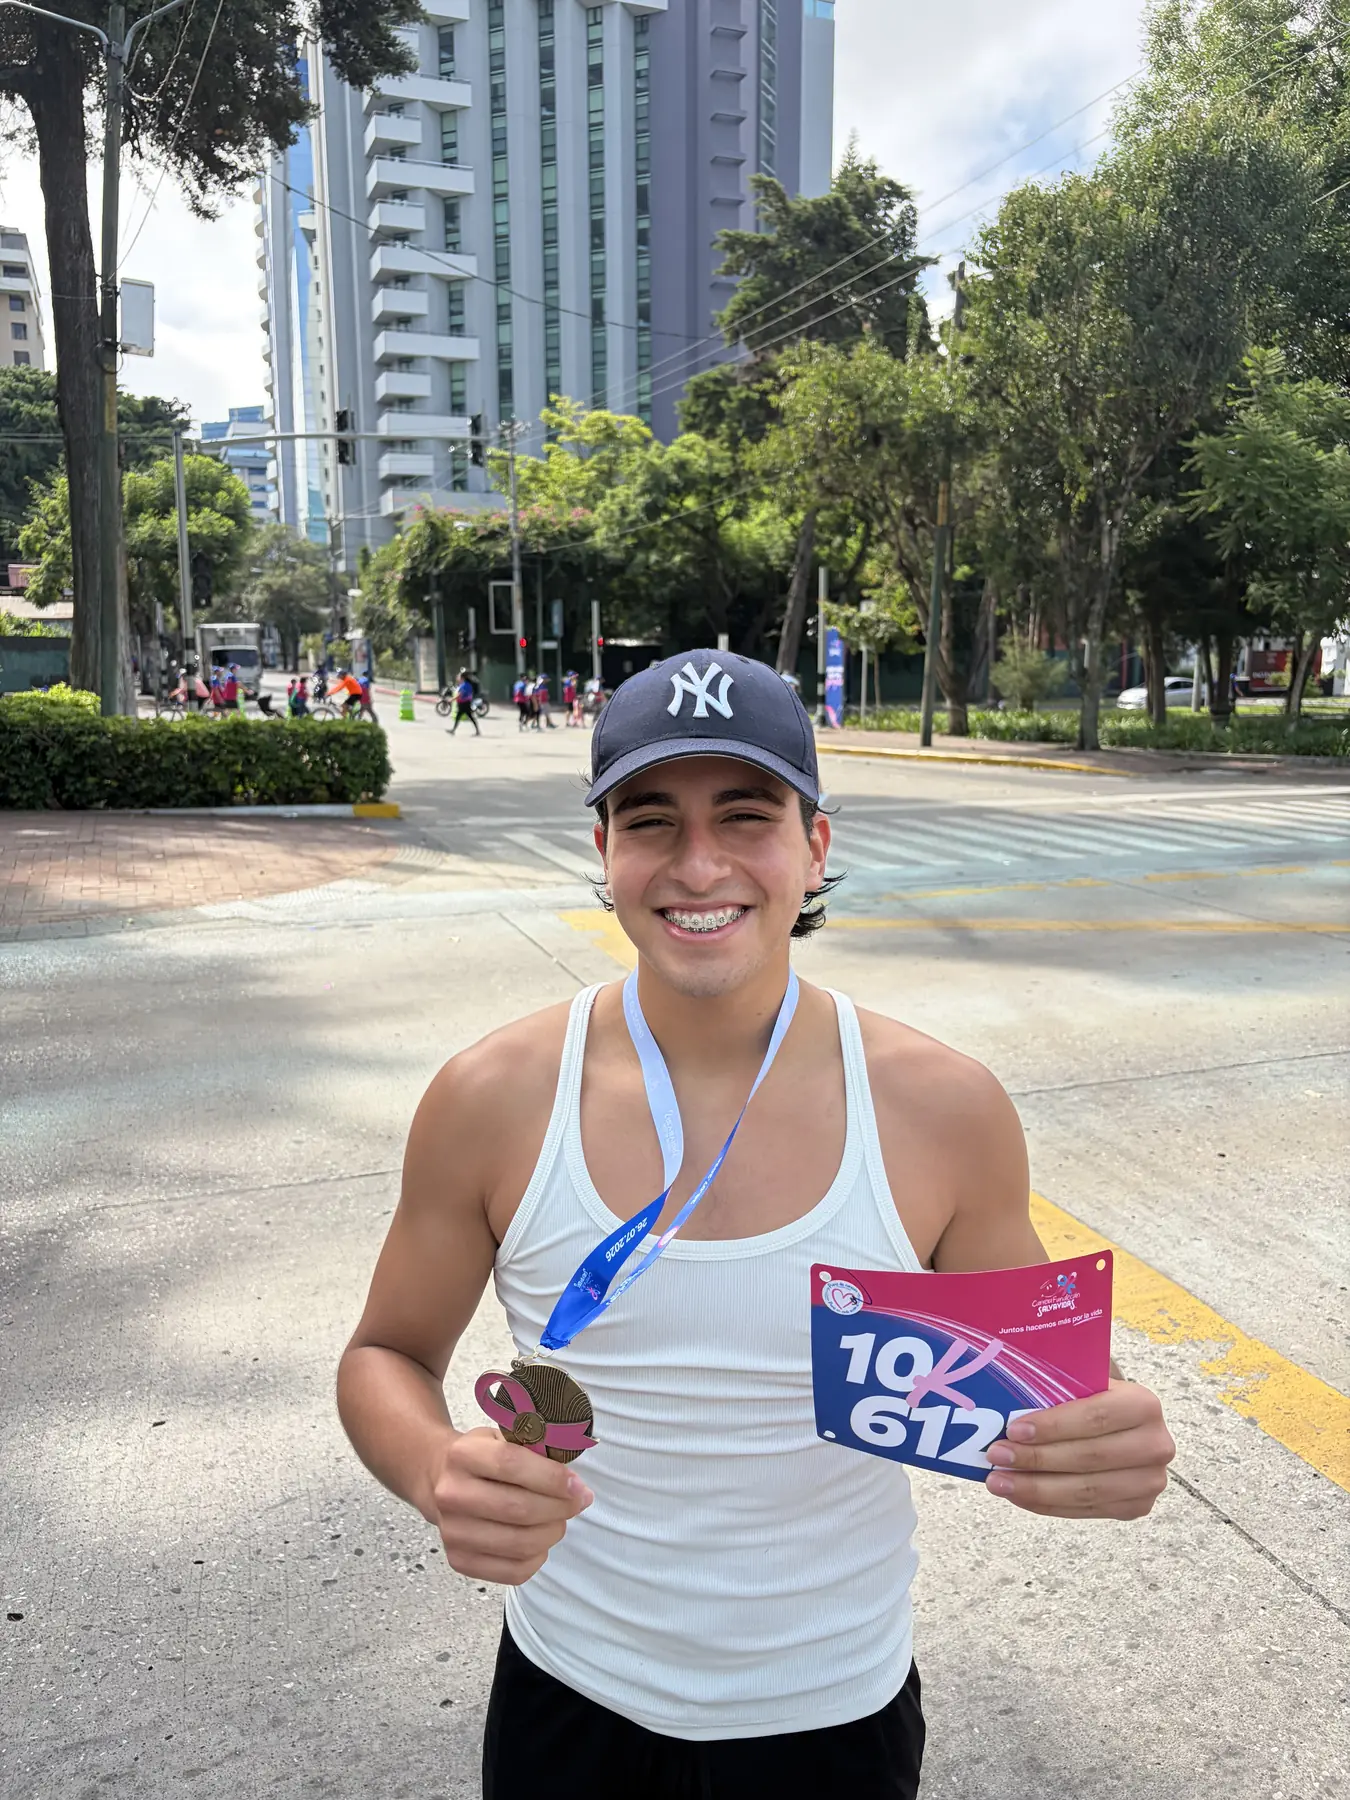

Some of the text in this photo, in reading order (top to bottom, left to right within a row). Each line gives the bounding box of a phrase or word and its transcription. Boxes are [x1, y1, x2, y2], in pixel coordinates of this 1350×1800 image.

[666, 661, 735, 720] NY
[999, 1325, 1025, 1335] Juntos
[1025, 1321, 1057, 1332] hacemos
[1057, 1316, 1072, 1326] más
[1072, 1314, 1084, 1324] por
[1090, 1308, 1103, 1317] vida
[850, 1395, 1042, 1471] 612
